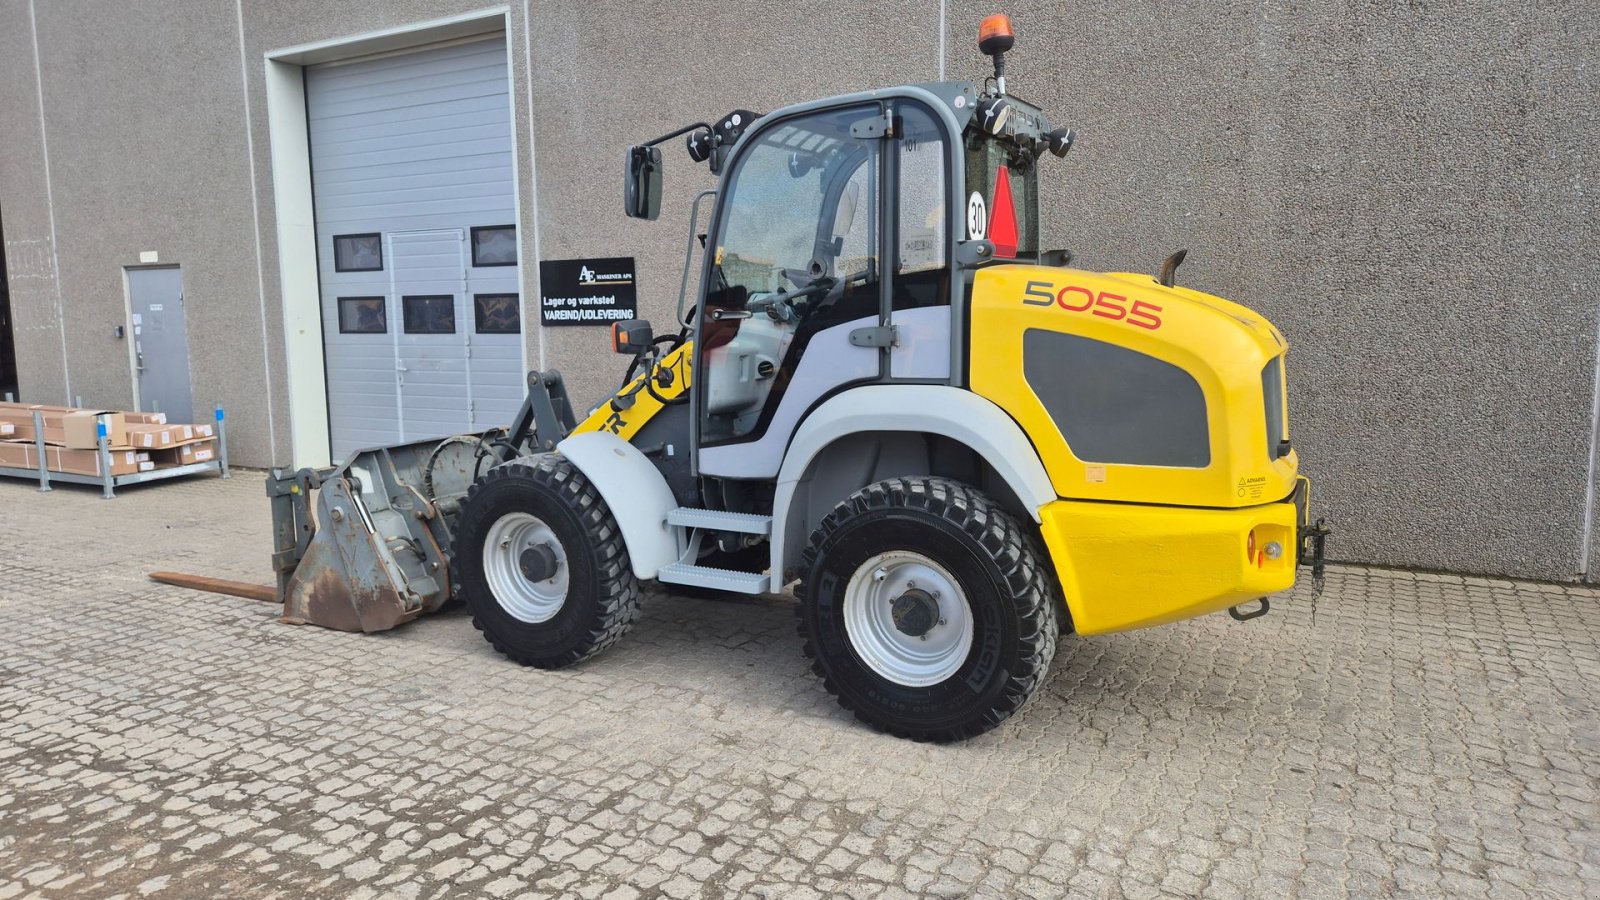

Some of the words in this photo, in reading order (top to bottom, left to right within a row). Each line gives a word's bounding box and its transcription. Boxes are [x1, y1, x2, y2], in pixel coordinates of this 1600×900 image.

[971, 201, 983, 235] 30
[543, 296, 565, 307] Lager
[567, 298, 577, 307] og
[578, 295, 616, 305] værksted
[1023, 280, 1163, 330] 5055
[544, 308, 634, 321] VAREIND/UDLEVERING
